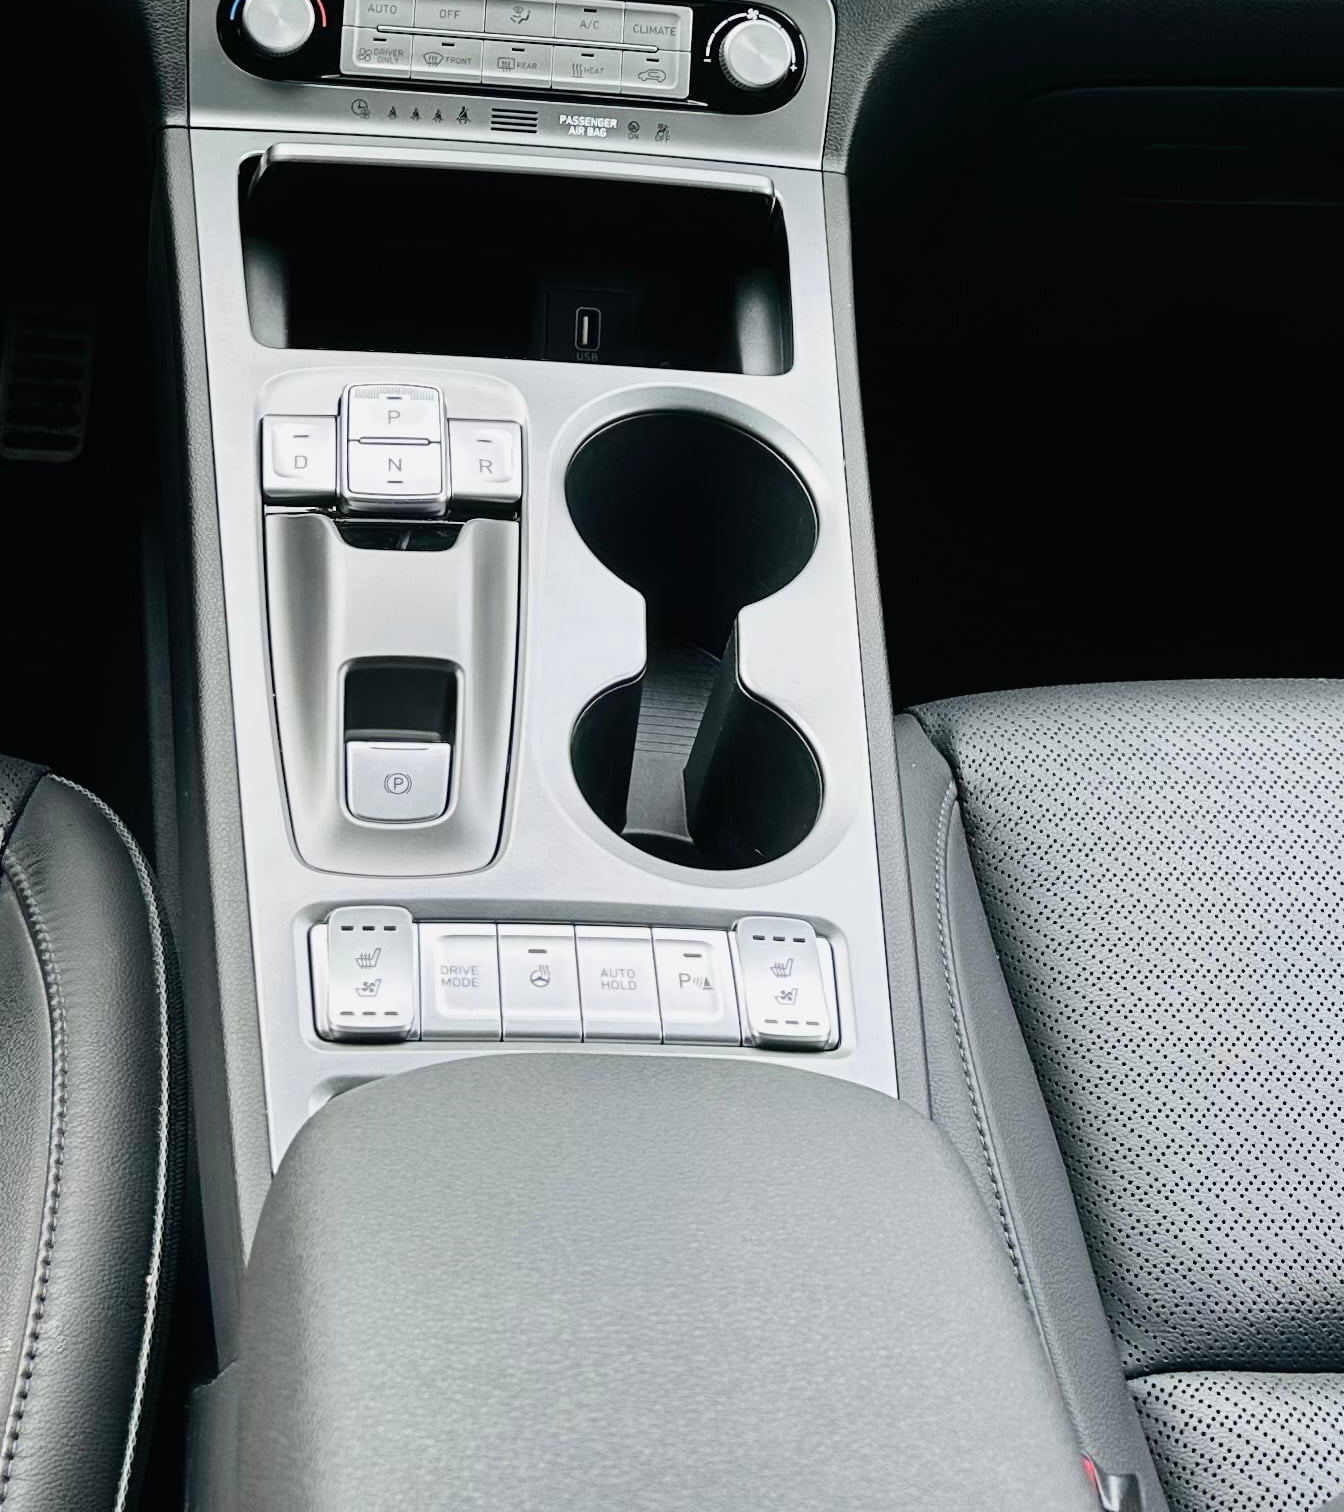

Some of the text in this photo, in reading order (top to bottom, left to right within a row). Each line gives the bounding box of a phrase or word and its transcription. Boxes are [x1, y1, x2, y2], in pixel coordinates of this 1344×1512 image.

[367, 4, 398, 15] AUTO
[439, 9, 461, 20] OFF
[579, 20, 600, 30] A/C
[632, 23, 677, 37] CLIMATE
[373, 48, 404, 58] DRIVER
[377, 56, 400, 64] ONLY
[445, 56, 472, 65] FRONT
[516, 61, 537, 70] REAR
[584, 66, 605, 75] HEAT
[559, 114, 618, 129] PASSENGER
[568, 126, 607, 138] AIR BAG
[576, 351, 599, 362] USB
[387, 410, 401, 424] P
[294, 455, 308, 470] D
[388, 458, 402, 472] N
[479, 458, 493, 474] R
[440, 965, 480, 976] DRIVE
[600, 968, 636, 979] AUTO
[441, 976, 480, 987] MODE
[601, 980, 637, 991] HOLD
